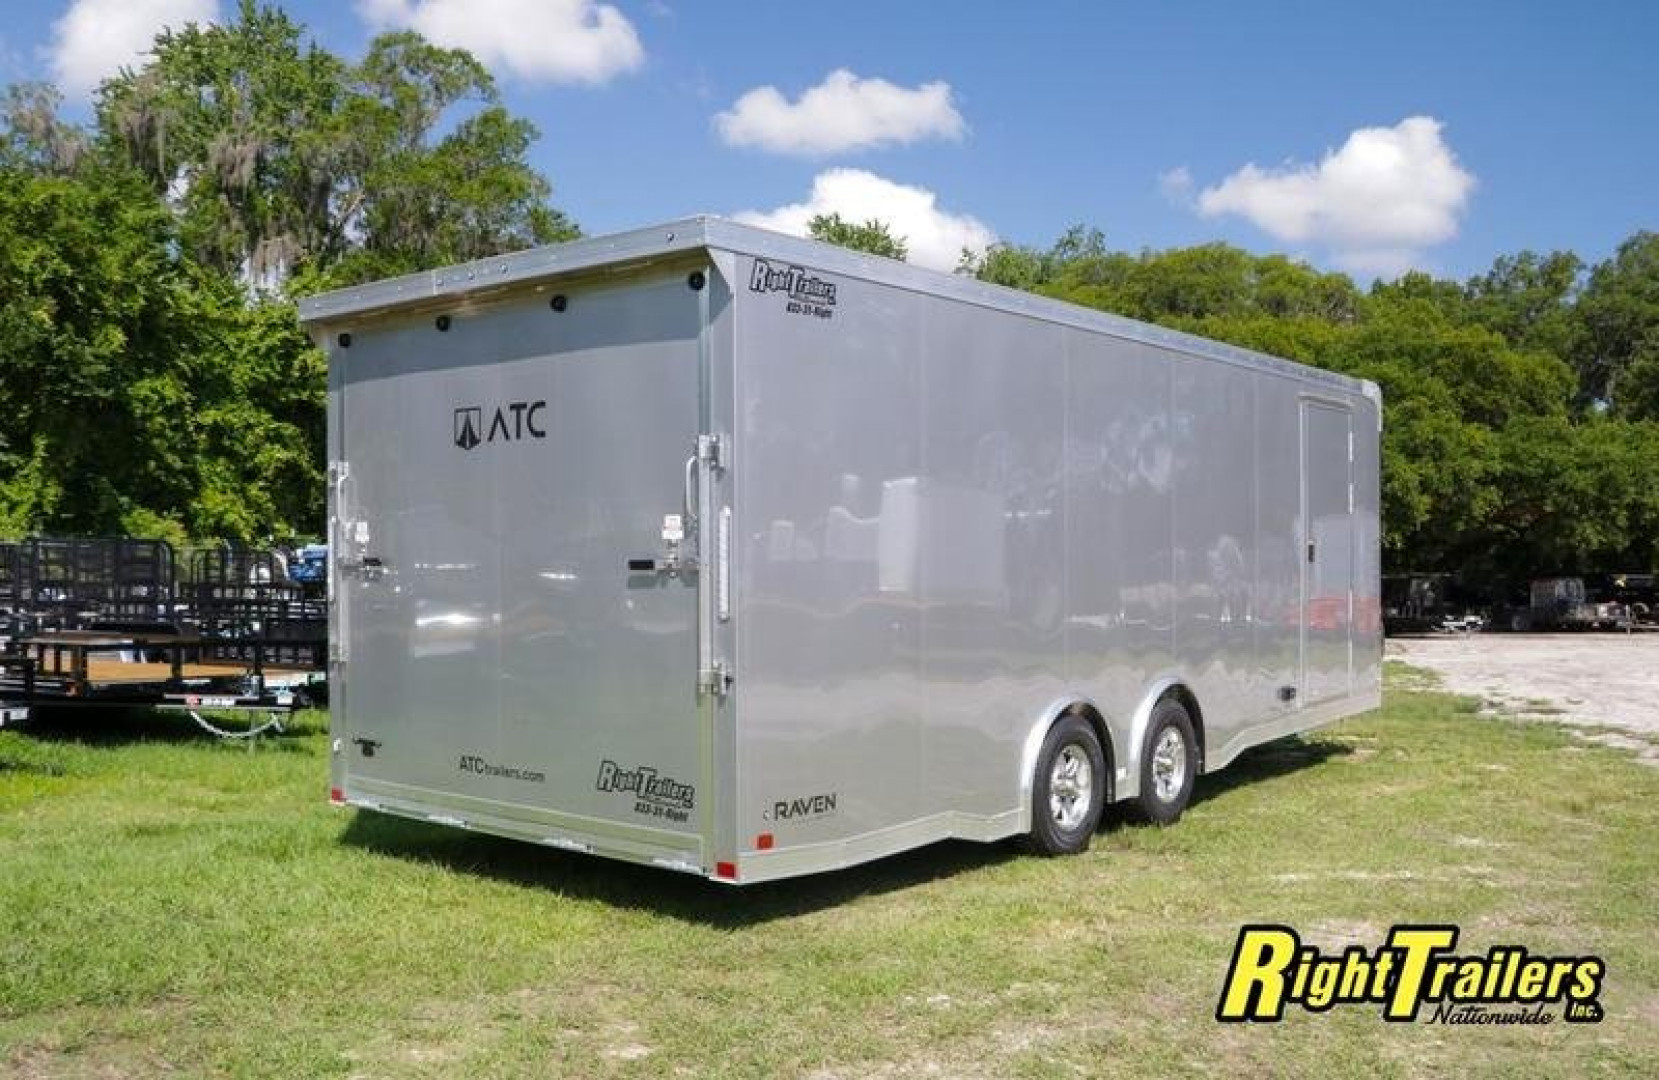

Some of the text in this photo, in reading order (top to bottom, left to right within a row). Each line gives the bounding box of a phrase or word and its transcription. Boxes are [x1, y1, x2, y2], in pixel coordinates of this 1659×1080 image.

[487, 401, 546, 442] ATC
[460, 756, 545, 782] ATCtrailers.com
[774, 792, 837, 821] RAVEN
